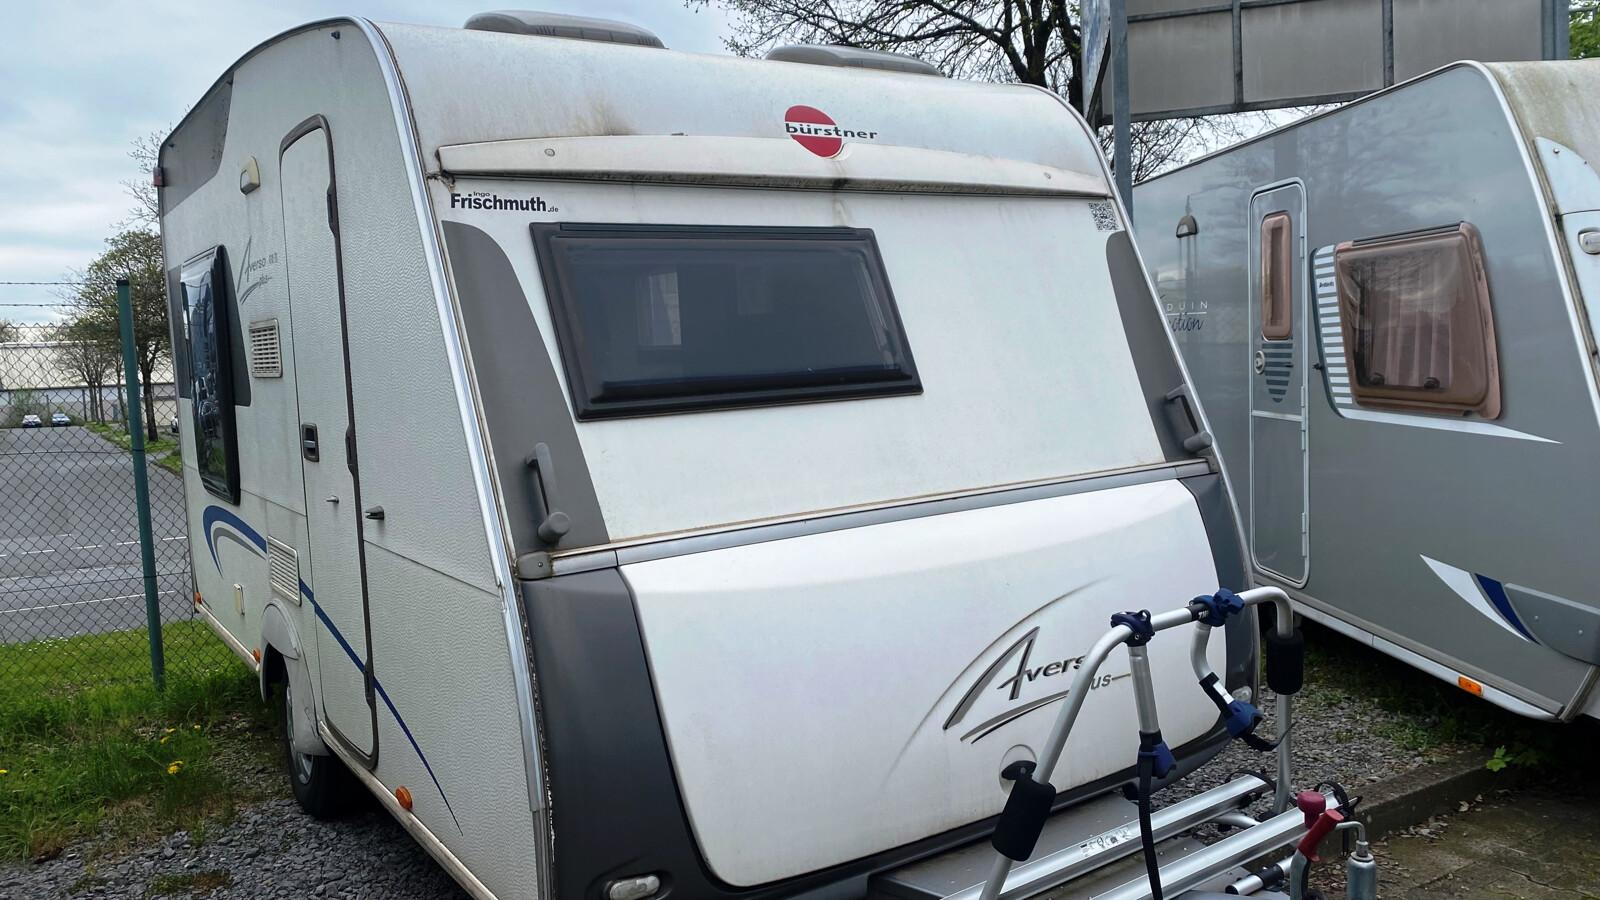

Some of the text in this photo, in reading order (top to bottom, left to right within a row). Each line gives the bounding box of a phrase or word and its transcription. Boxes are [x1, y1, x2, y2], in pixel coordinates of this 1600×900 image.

[785, 122, 878, 139] bürstner
[1166, 300, 1208, 312] DUIN
[942, 625, 1088, 731] Avers
